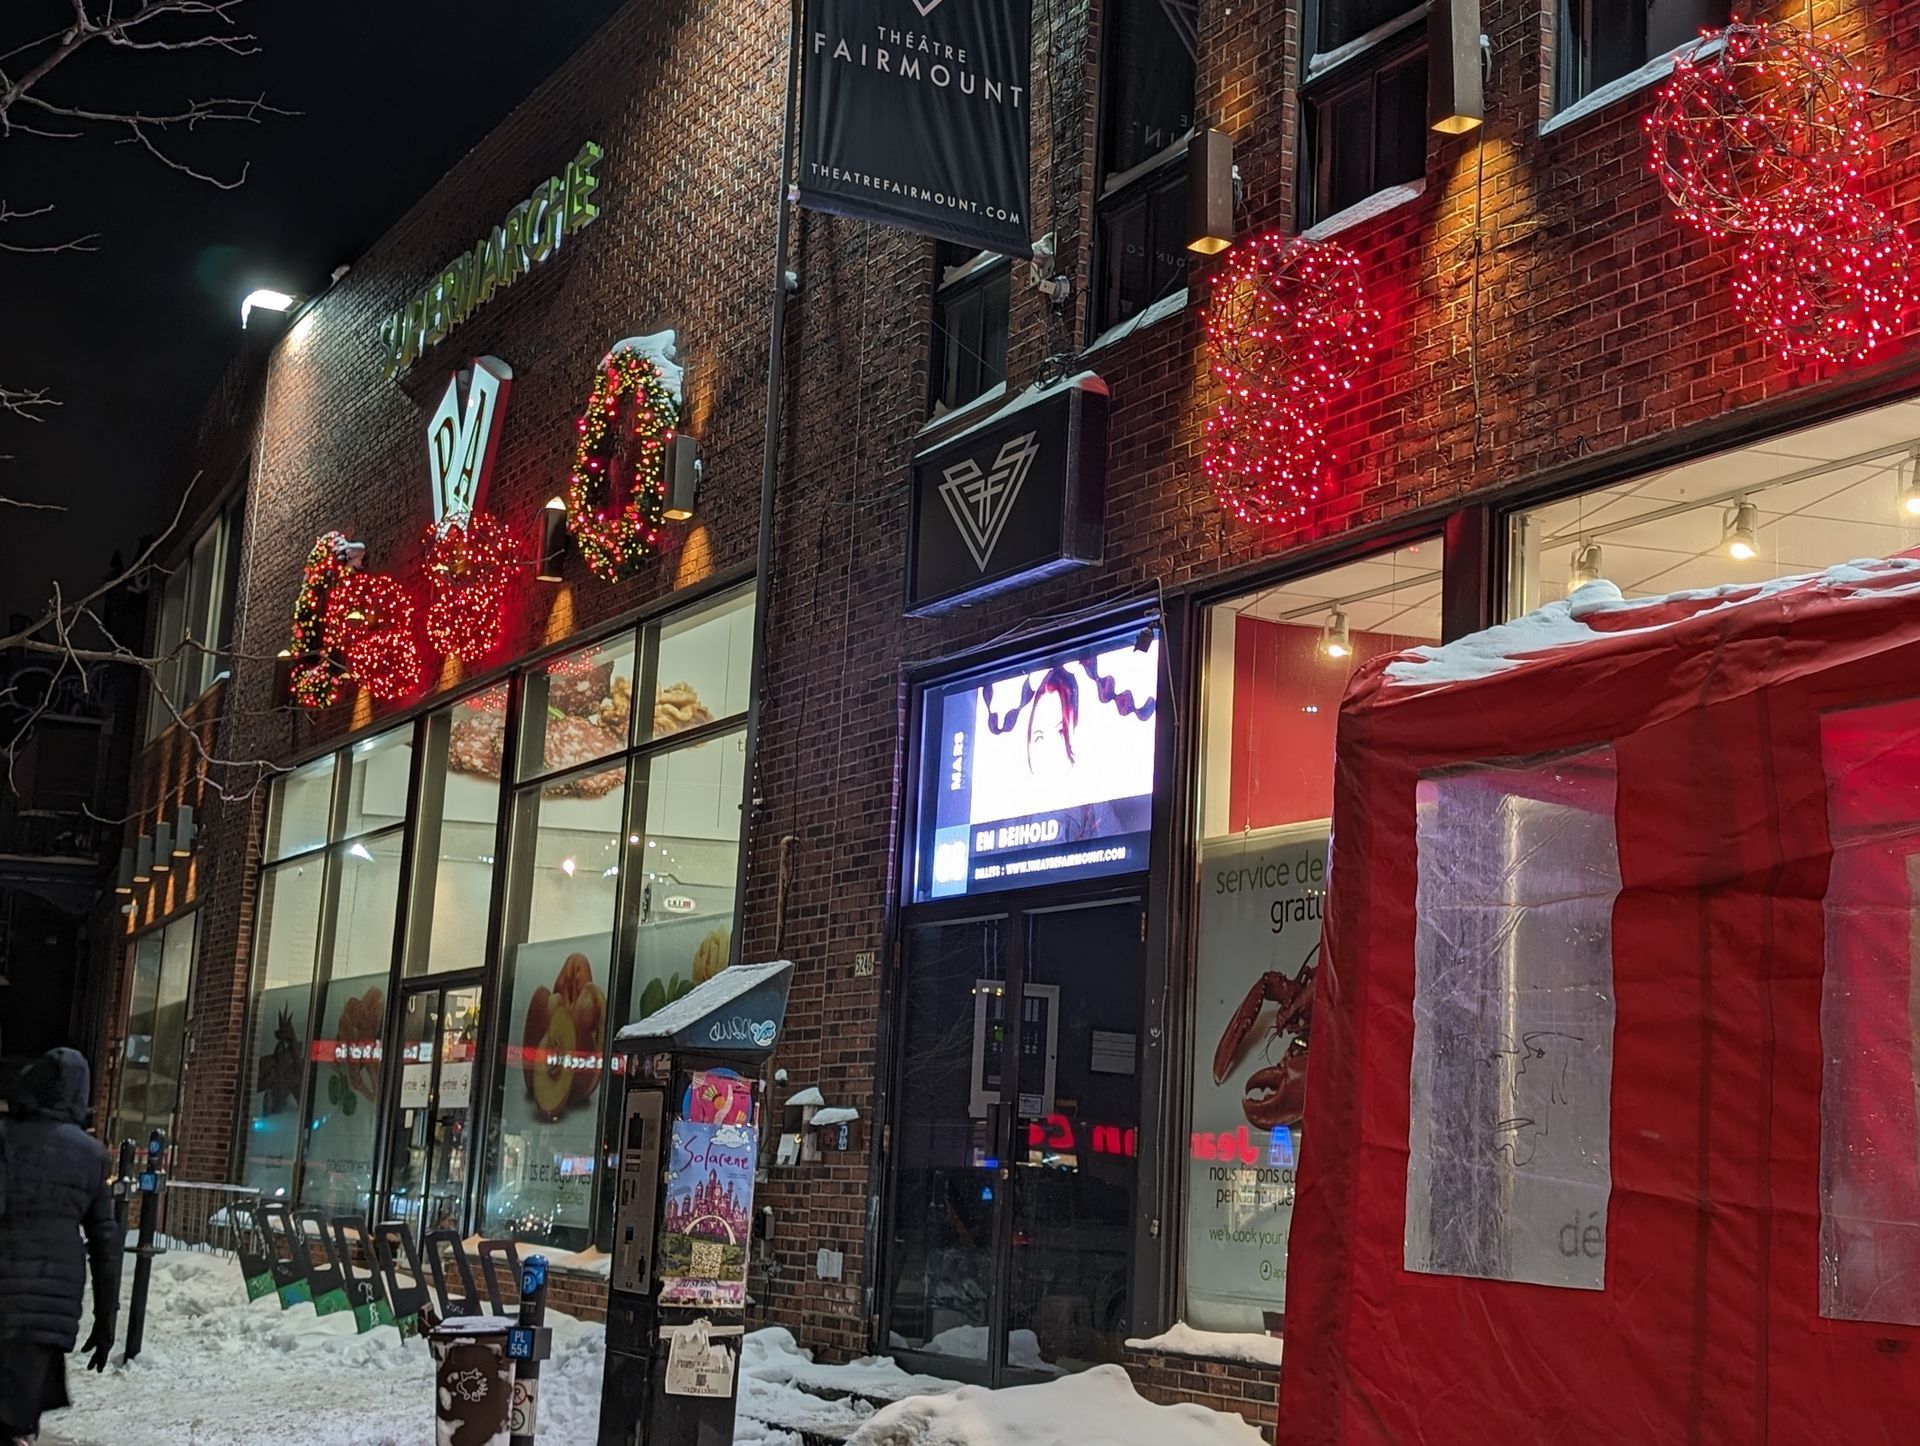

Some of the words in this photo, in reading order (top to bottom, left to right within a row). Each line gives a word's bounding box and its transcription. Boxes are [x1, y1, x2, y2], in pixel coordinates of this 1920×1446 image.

[877, 25, 967, 64] THÉÂTRE
[814, 32, 1023, 108] FAIRMOUNT
[811, 163, 1020, 225] THEATREFAIRMOUNT.COM
[951, 731, 965, 791] MARS
[975, 829, 995, 852] EM
[998, 819, 1059, 849] BEIHOLD
[1216, 856, 1290, 895] service
[1295, 849, 1323, 884] de
[1209, 1166, 1237, 1182] nous
[1232, 1227, 1257, 1243] cook
[1259, 1232, 1283, 1249] your
[511, 1343, 528, 1356] 554
[514, 1330, 526, 1343] PL
